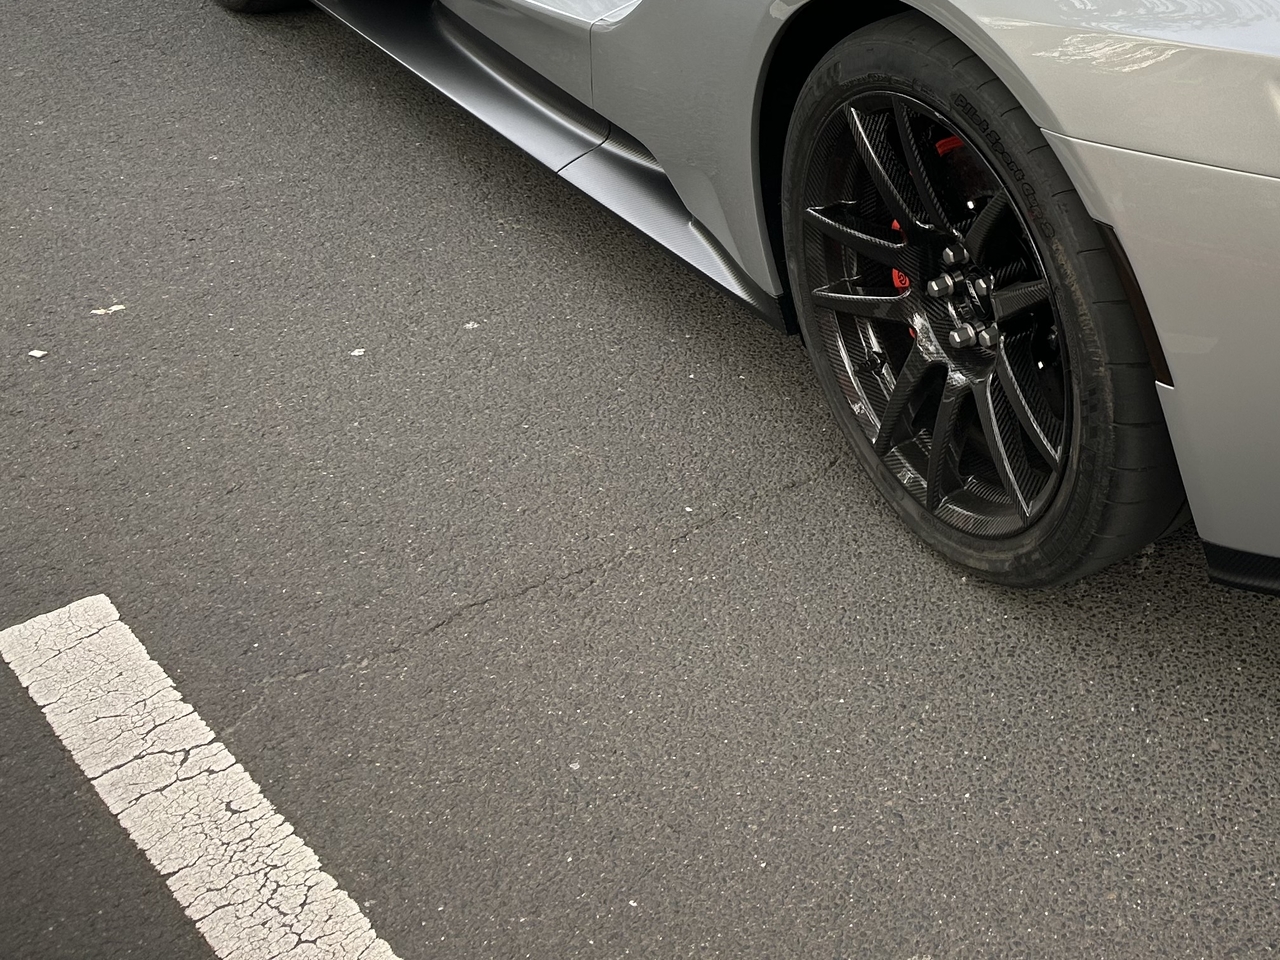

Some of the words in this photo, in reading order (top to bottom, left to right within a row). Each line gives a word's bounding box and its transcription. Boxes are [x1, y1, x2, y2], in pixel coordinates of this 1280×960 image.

[954, 93, 989, 133] Pilot
[986, 130, 1026, 182] Sport
[1021, 182, 1042, 219] Cup
